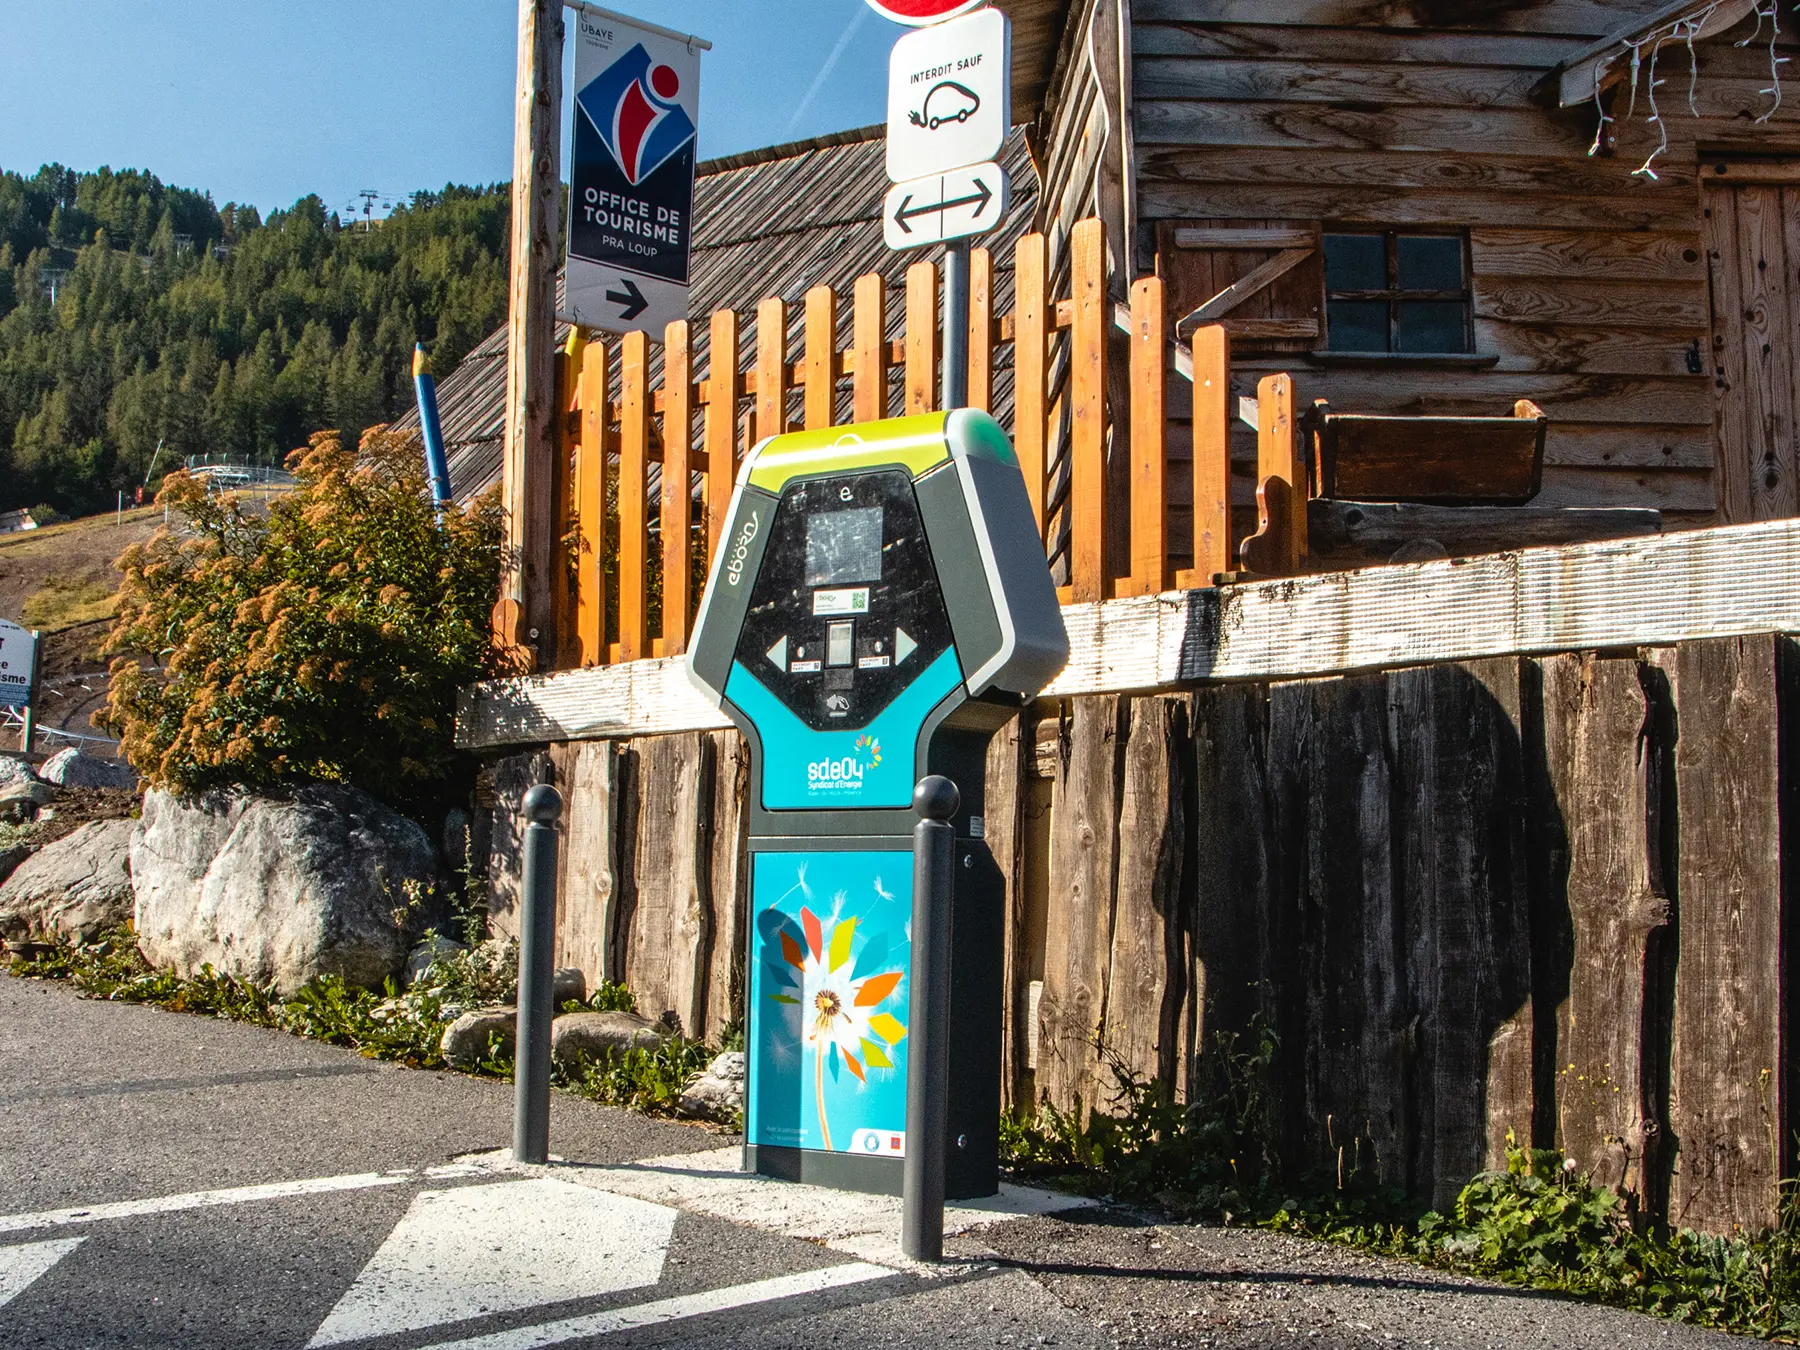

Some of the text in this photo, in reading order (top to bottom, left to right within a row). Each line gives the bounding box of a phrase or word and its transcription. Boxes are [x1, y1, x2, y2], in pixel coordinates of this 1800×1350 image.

[581, 23, 614, 41] UBAYE
[910, 54, 983, 84] INTERDIT SAUF
[584, 187, 680, 226] OFFICE DE
[583, 205, 679, 245] TOURISME
[602, 235, 658, 257] PRA LOUP
[807, 757, 864, 781] sde04
[807, 780, 835, 791] Syndicat
